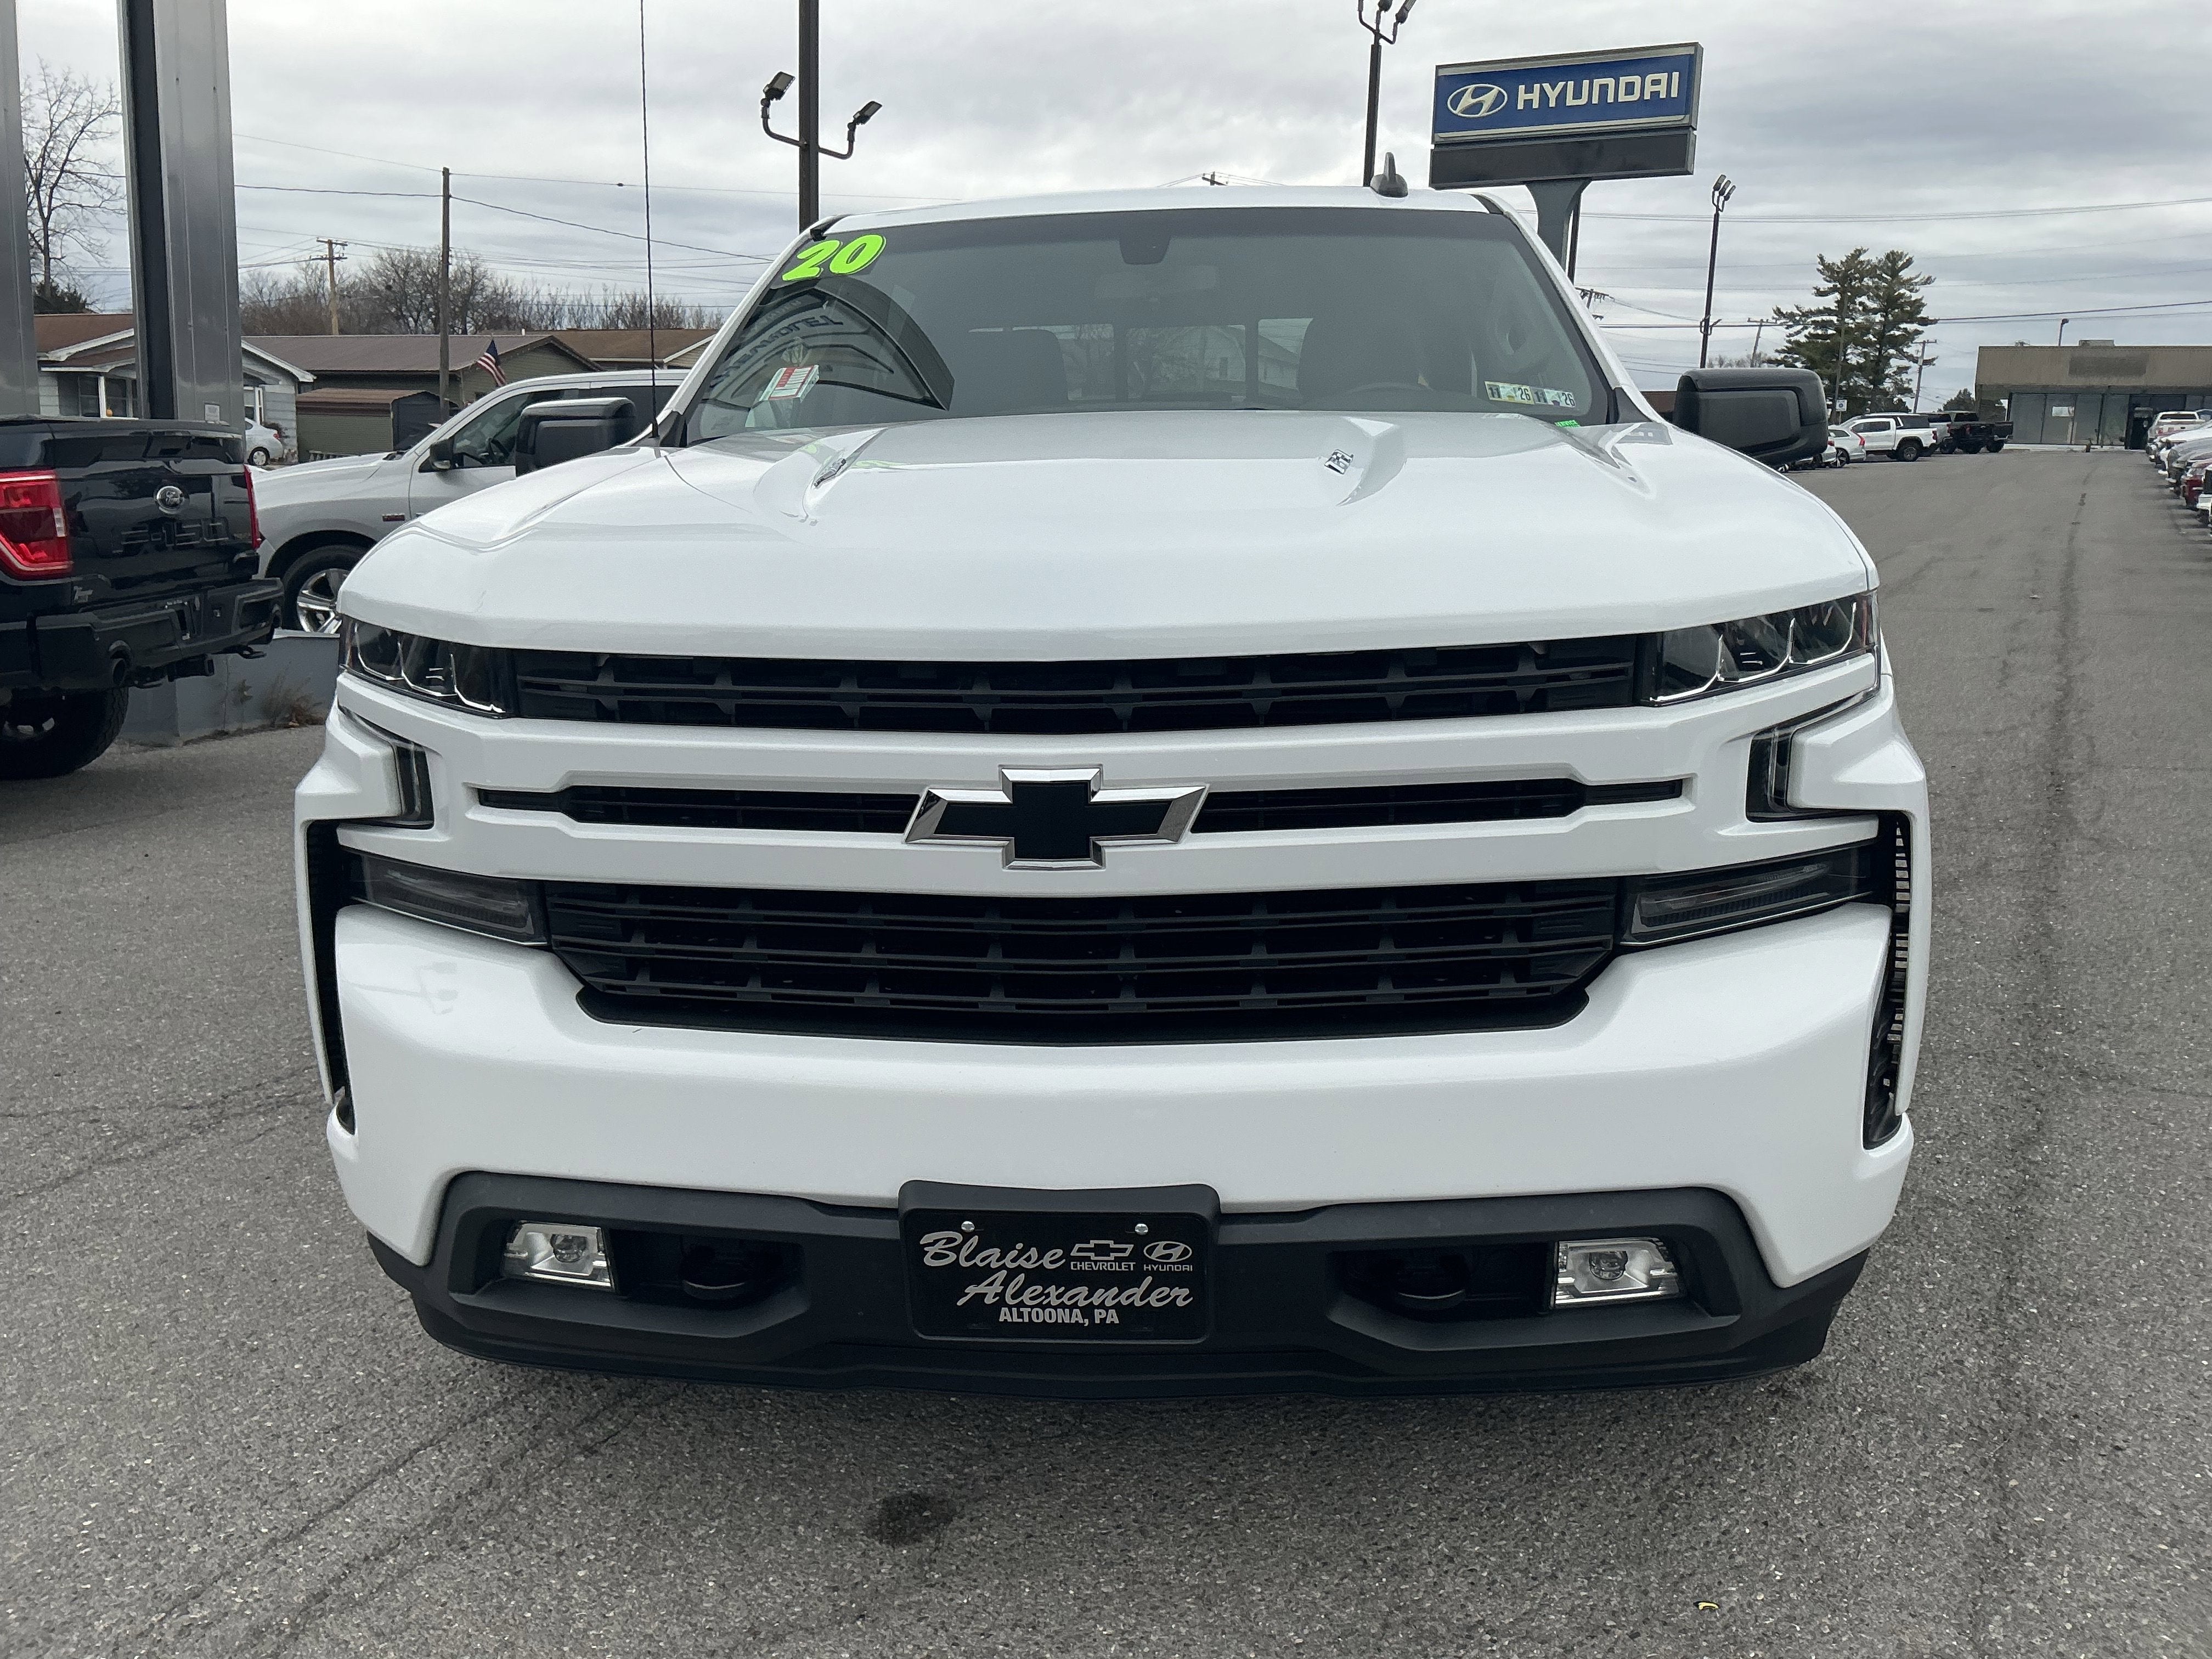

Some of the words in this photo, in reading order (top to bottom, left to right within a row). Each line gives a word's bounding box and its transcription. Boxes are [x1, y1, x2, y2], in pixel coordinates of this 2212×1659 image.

[1517, 71, 1679, 110] HYUNDAI
[781, 234, 887, 281] 20
[1488, 386, 1502, 399] 11
[1518, 387, 1531, 401] 26
[1562, 392, 1576, 407] 26
[919, 1231, 1065, 1269] Blaise
[1070, 1261, 1136, 1272] CHEVROLET
[956, 1270, 1193, 1307] Alexander
[998, 1307, 1089, 1327] ALTOONA,
[1094, 1309, 1119, 1324] PA
